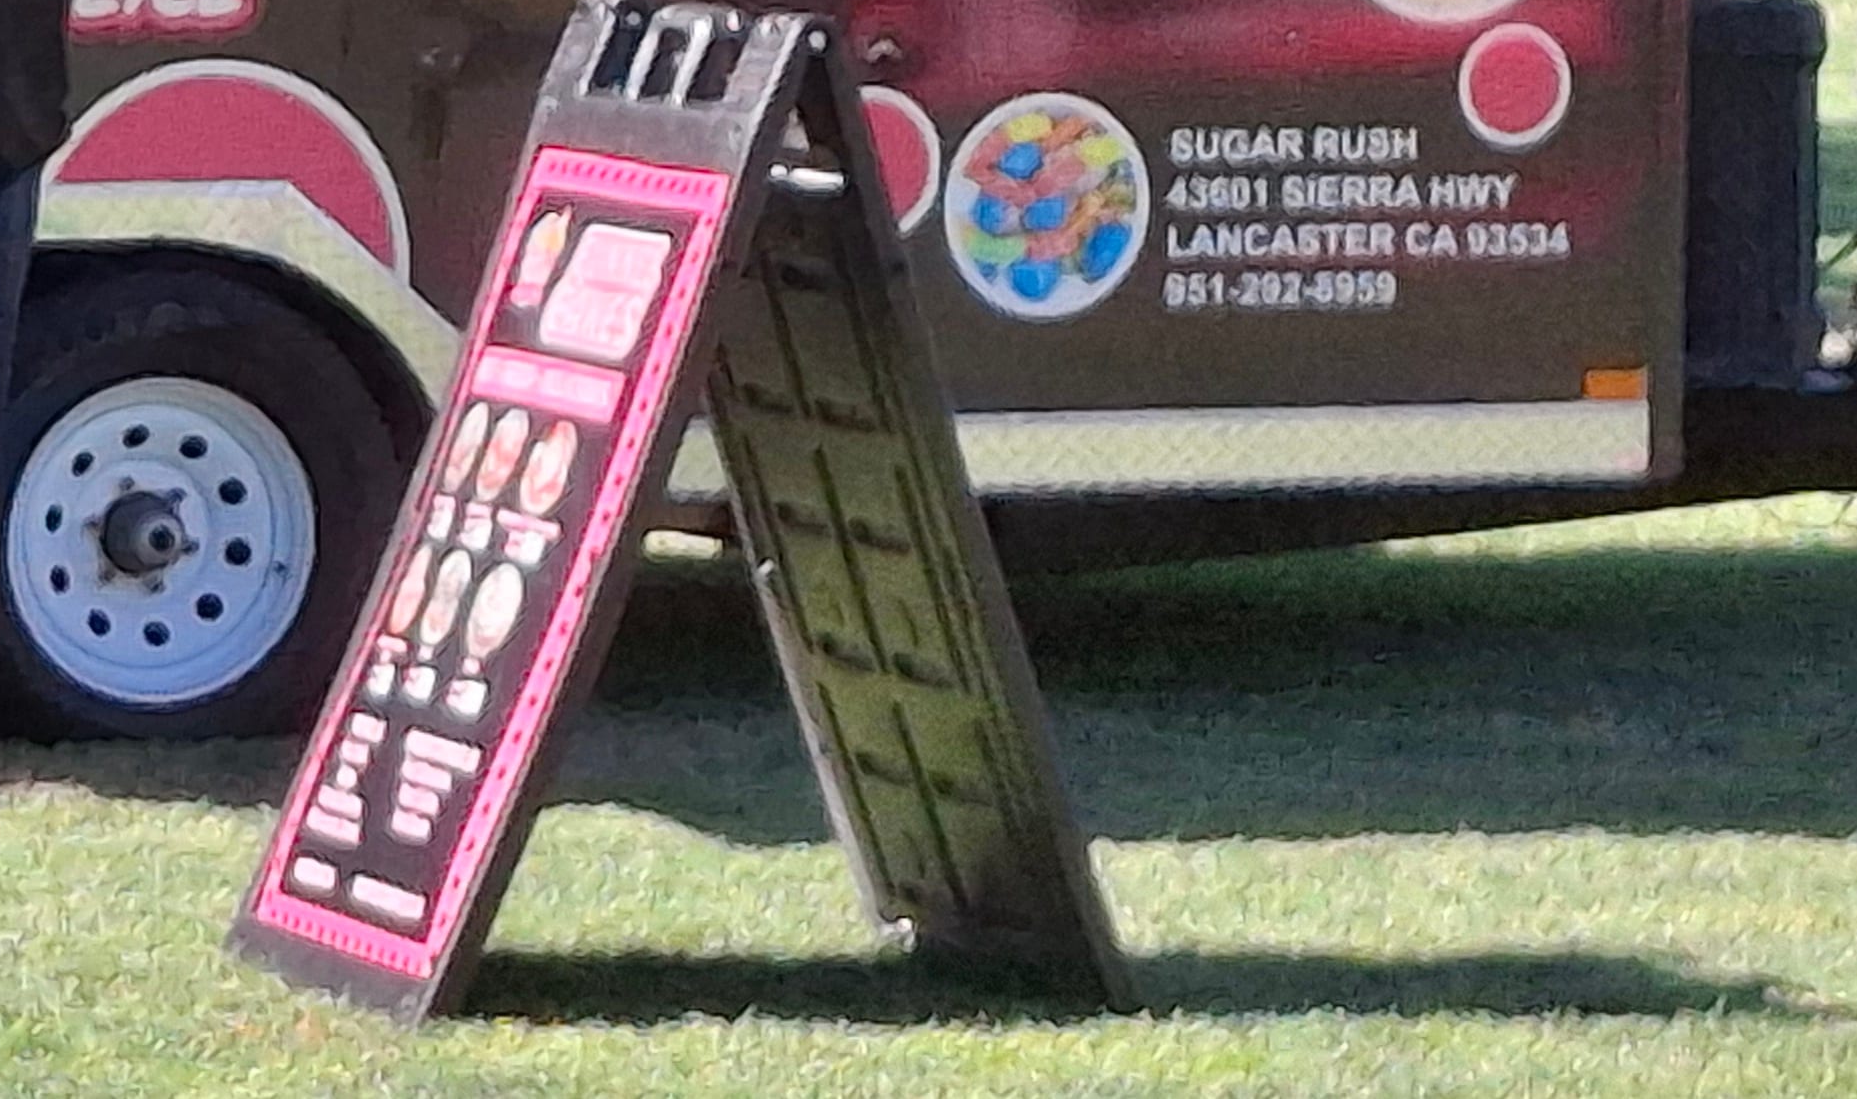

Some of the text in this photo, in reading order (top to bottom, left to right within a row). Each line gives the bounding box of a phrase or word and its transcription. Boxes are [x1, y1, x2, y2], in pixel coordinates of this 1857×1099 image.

[1170, 127, 1418, 162] SUGAR RUSH
[1282, 174, 1421, 209] SIERRA
[1428, 172, 1518, 209] HWY
[1167, 221, 1394, 258] LANCASTER
[1405, 221, 1459, 258] CA
